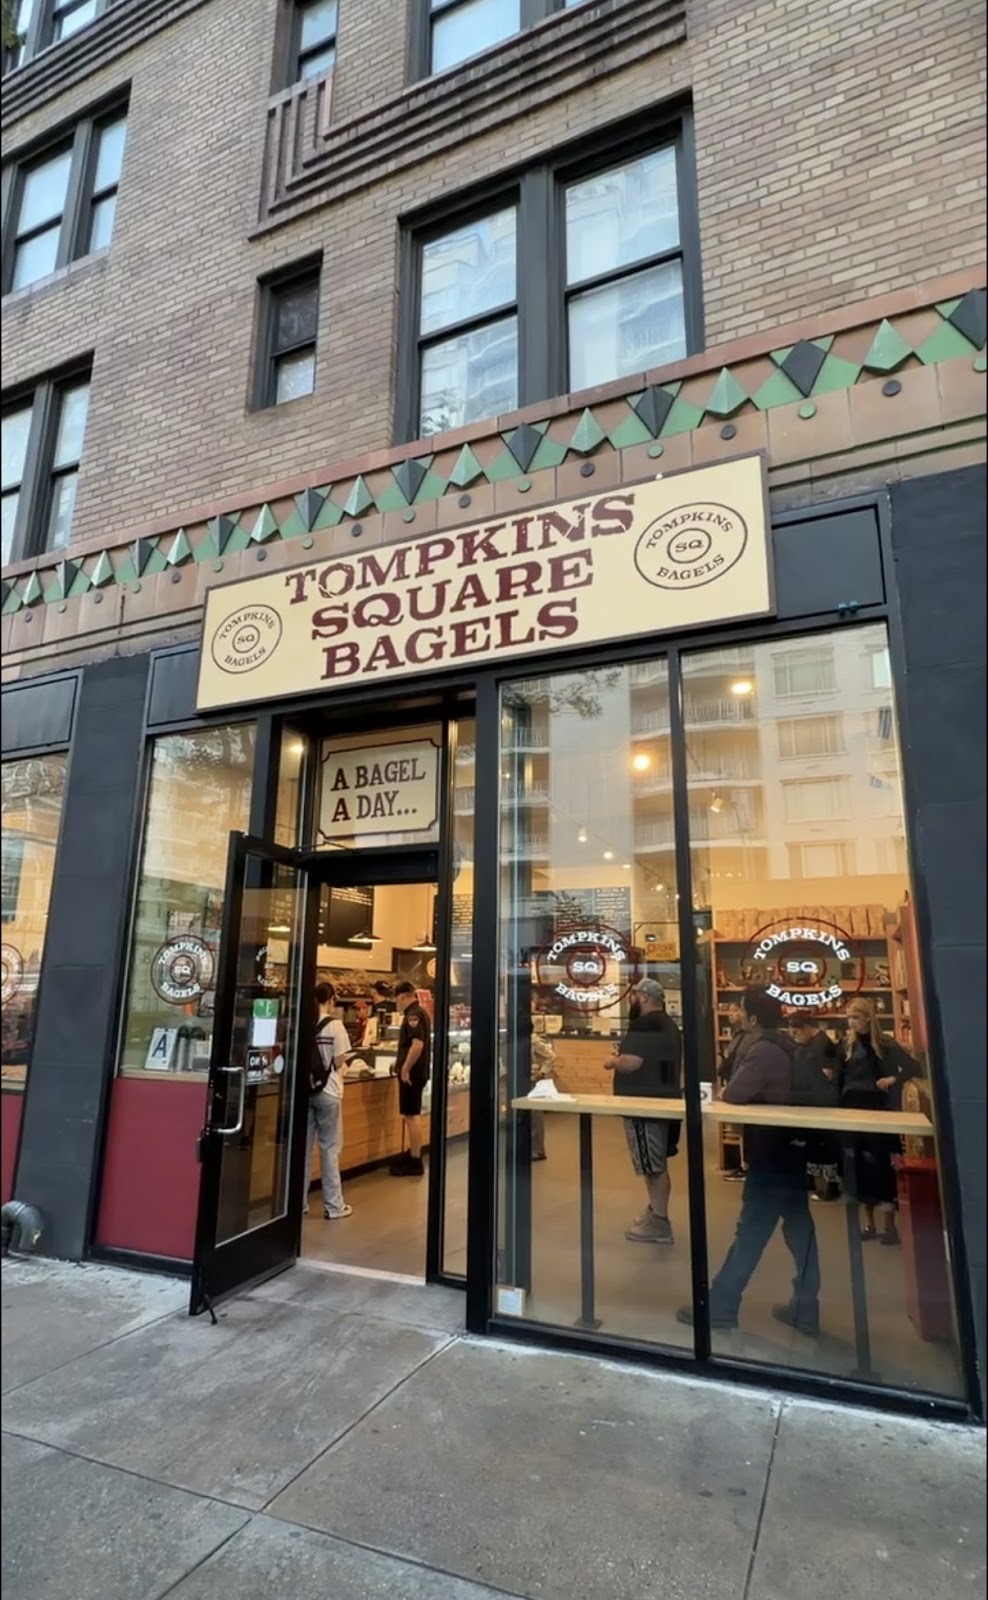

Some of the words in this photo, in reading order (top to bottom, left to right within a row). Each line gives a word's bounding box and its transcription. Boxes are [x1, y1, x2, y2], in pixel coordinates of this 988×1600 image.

[645, 512, 734, 549] TOMPKINS
[285, 493, 635, 605] TOMPKINS
[675, 539, 704, 553] SQ
[656, 554, 725, 580] BAGELS
[311, 547, 594, 641] SQUARE
[219, 612, 275, 639] TOMPKINS
[236, 634, 255, 645] SQ
[320, 597, 580, 681] BAGELS
[224, 647, 266, 666] BAGELS
[330, 767, 350, 791] A
[354, 758, 427, 789] BAGEL
[331, 797, 351, 822] A
[356, 790, 417, 819] DAY...
[547, 931, 626, 962] TOMPKINS
[753, 927, 851, 961] TOMPKINS
[174, 965, 192, 975] SQ
[572, 961, 599, 974] SQ
[786, 961, 819, 973] SQ
[160, 982, 203, 998] BAGELS
[765, 983, 843, 1006] BAGELS
[151, 1033, 168, 1058] A
